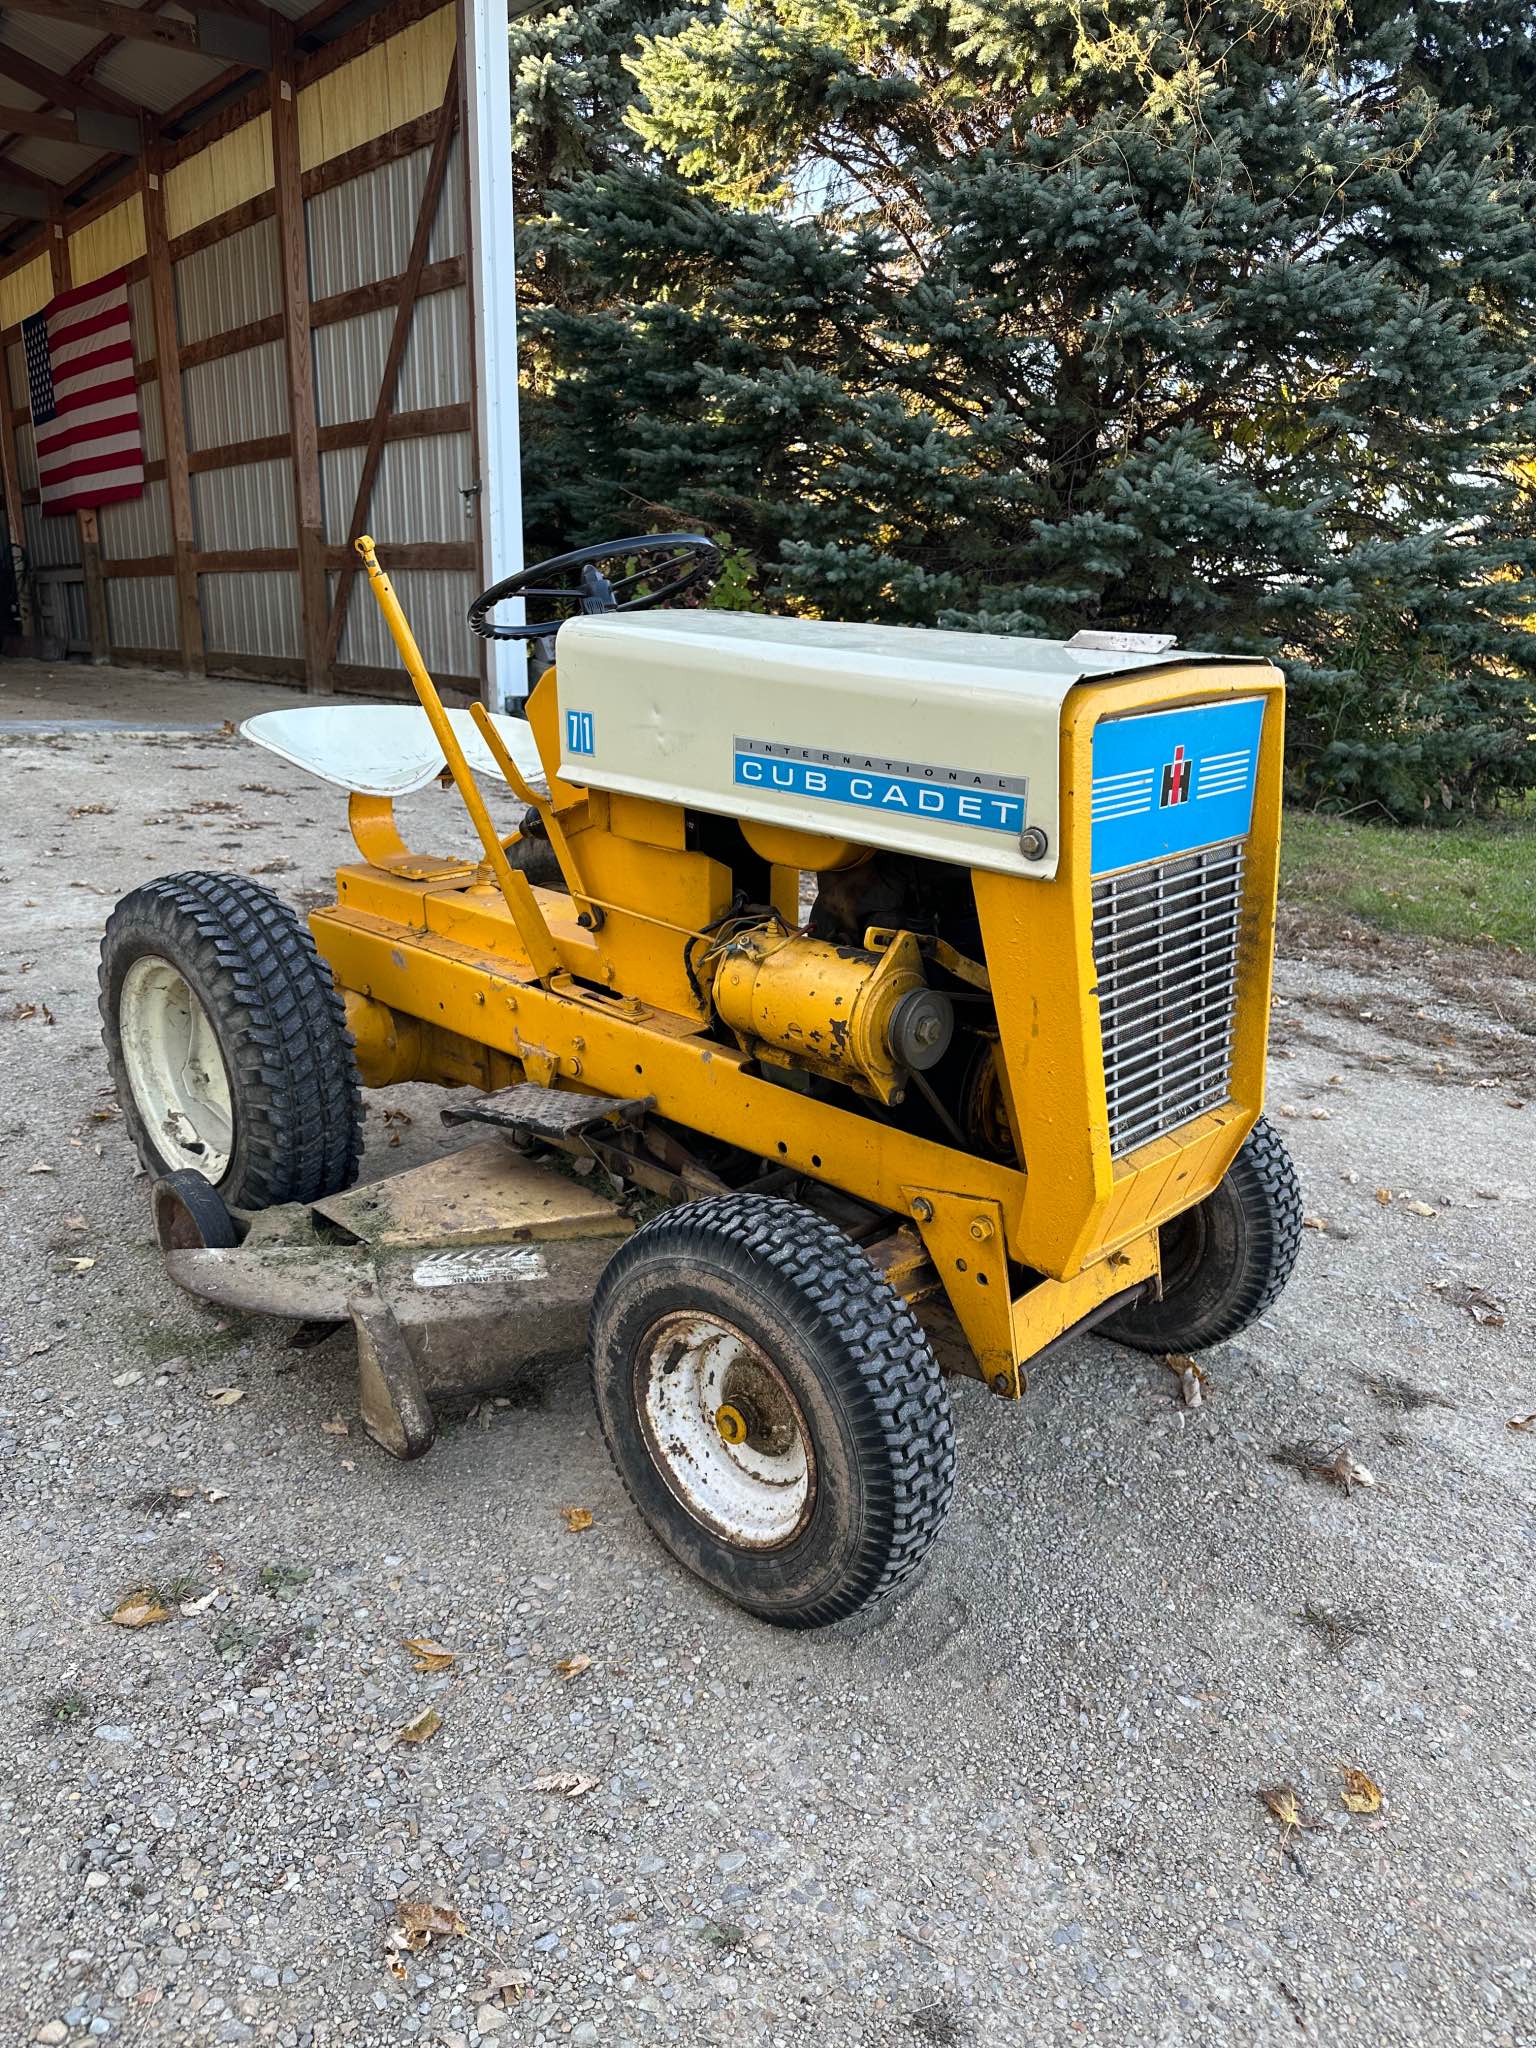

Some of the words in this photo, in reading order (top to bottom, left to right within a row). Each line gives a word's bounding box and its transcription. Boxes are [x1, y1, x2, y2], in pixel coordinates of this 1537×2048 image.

[570, 714, 590, 750] 71
[749, 742, 1006, 788] INTERNATIONAL
[742, 761, 827, 792] CUB
[850, 778, 1018, 824] CADET
